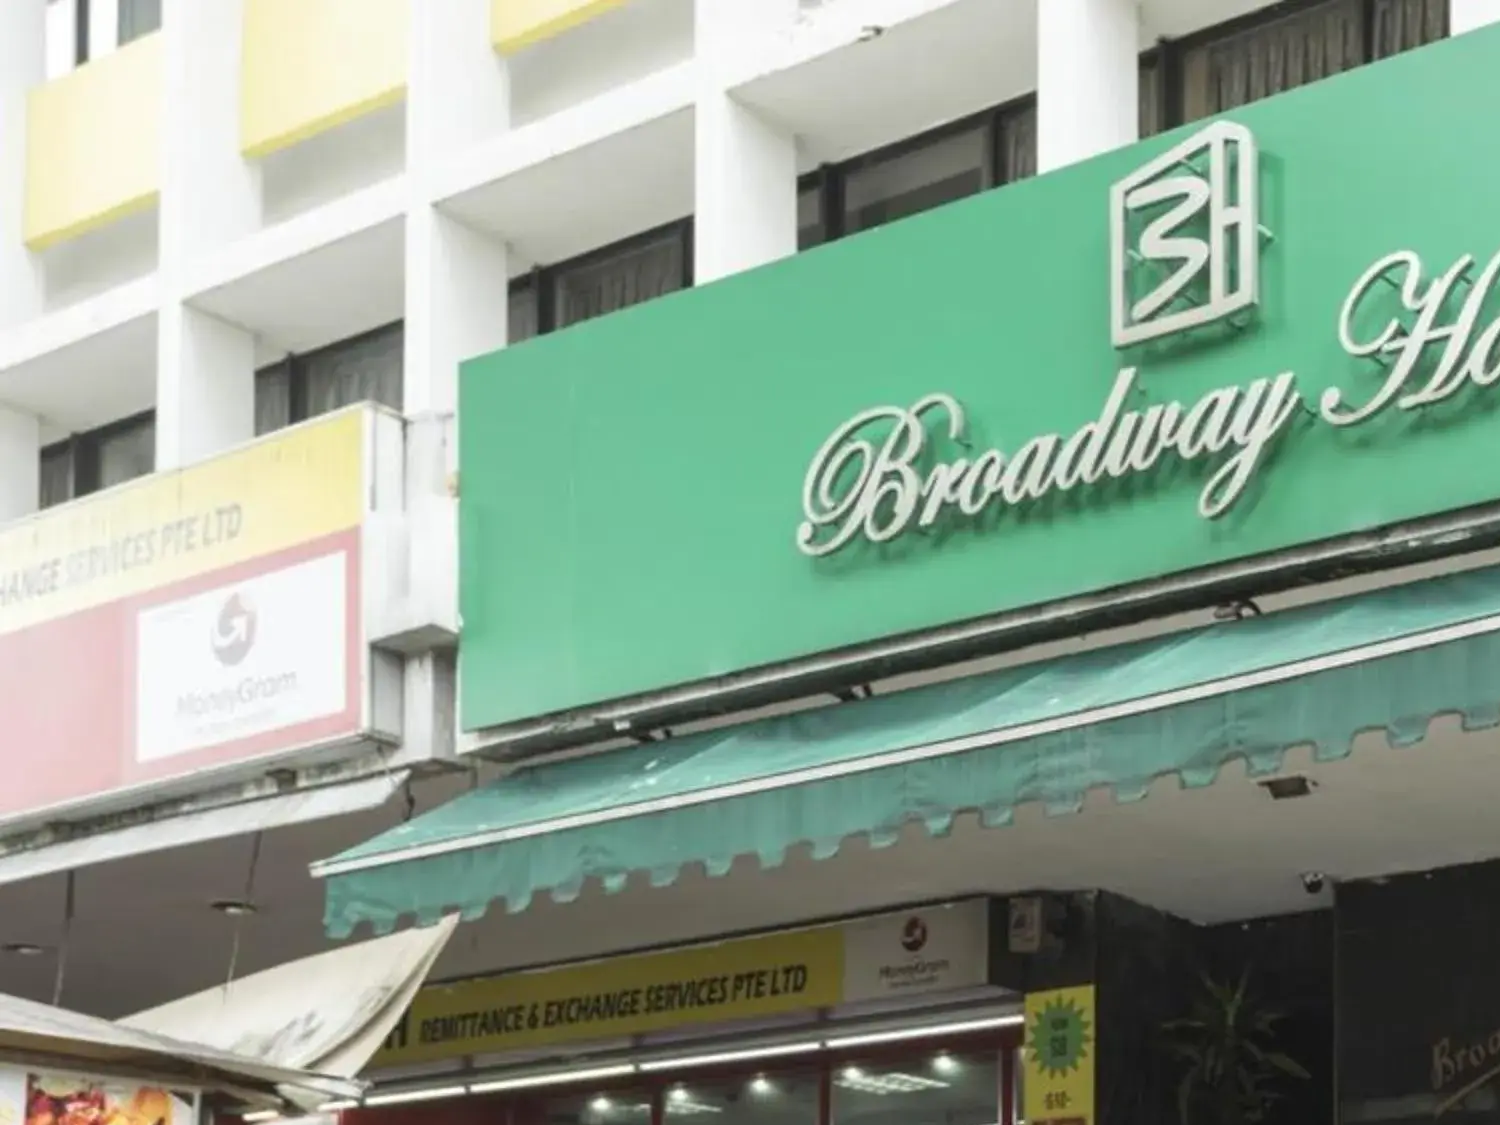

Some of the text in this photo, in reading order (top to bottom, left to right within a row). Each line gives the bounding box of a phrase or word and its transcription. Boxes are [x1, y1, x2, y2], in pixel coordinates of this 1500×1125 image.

[797, 368, 1301, 555] Broadway
[66, 529, 155, 587] SERVICES
[162, 517, 197, 558] PTE
[203, 503, 242, 546] LTD
[176, 672, 297, 713] MoneyGram
[419, 1004, 524, 1044] REMITTANCE
[527, 1001, 540, 1029] &
[543, 989, 640, 1027] EXCHANGE
[645, 977, 727, 1015] SERVICES
[733, 970, 766, 1000] PTE
[771, 964, 808, 994] LTD
